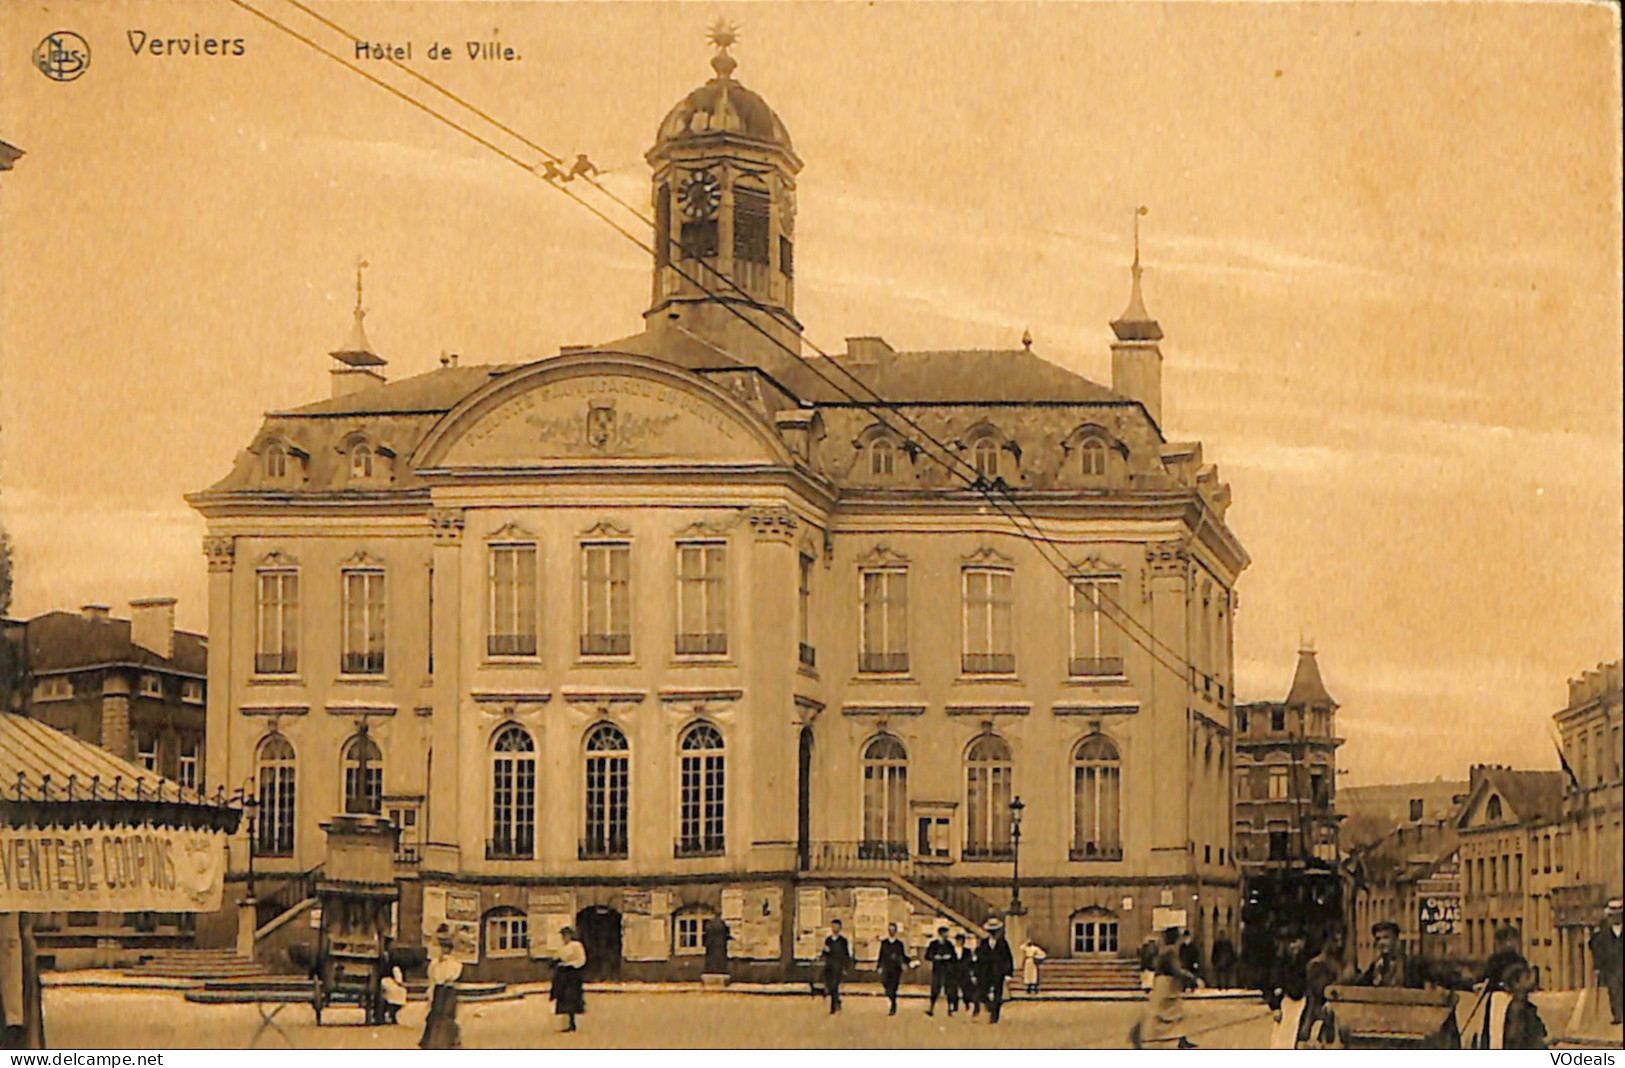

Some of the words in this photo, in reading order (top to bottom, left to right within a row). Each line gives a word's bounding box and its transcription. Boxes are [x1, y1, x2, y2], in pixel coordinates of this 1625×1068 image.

[0, 838, 70, 891] VENTE
[73, 838, 98, 891] DE
[102, 835, 176, 892] COUPONS
